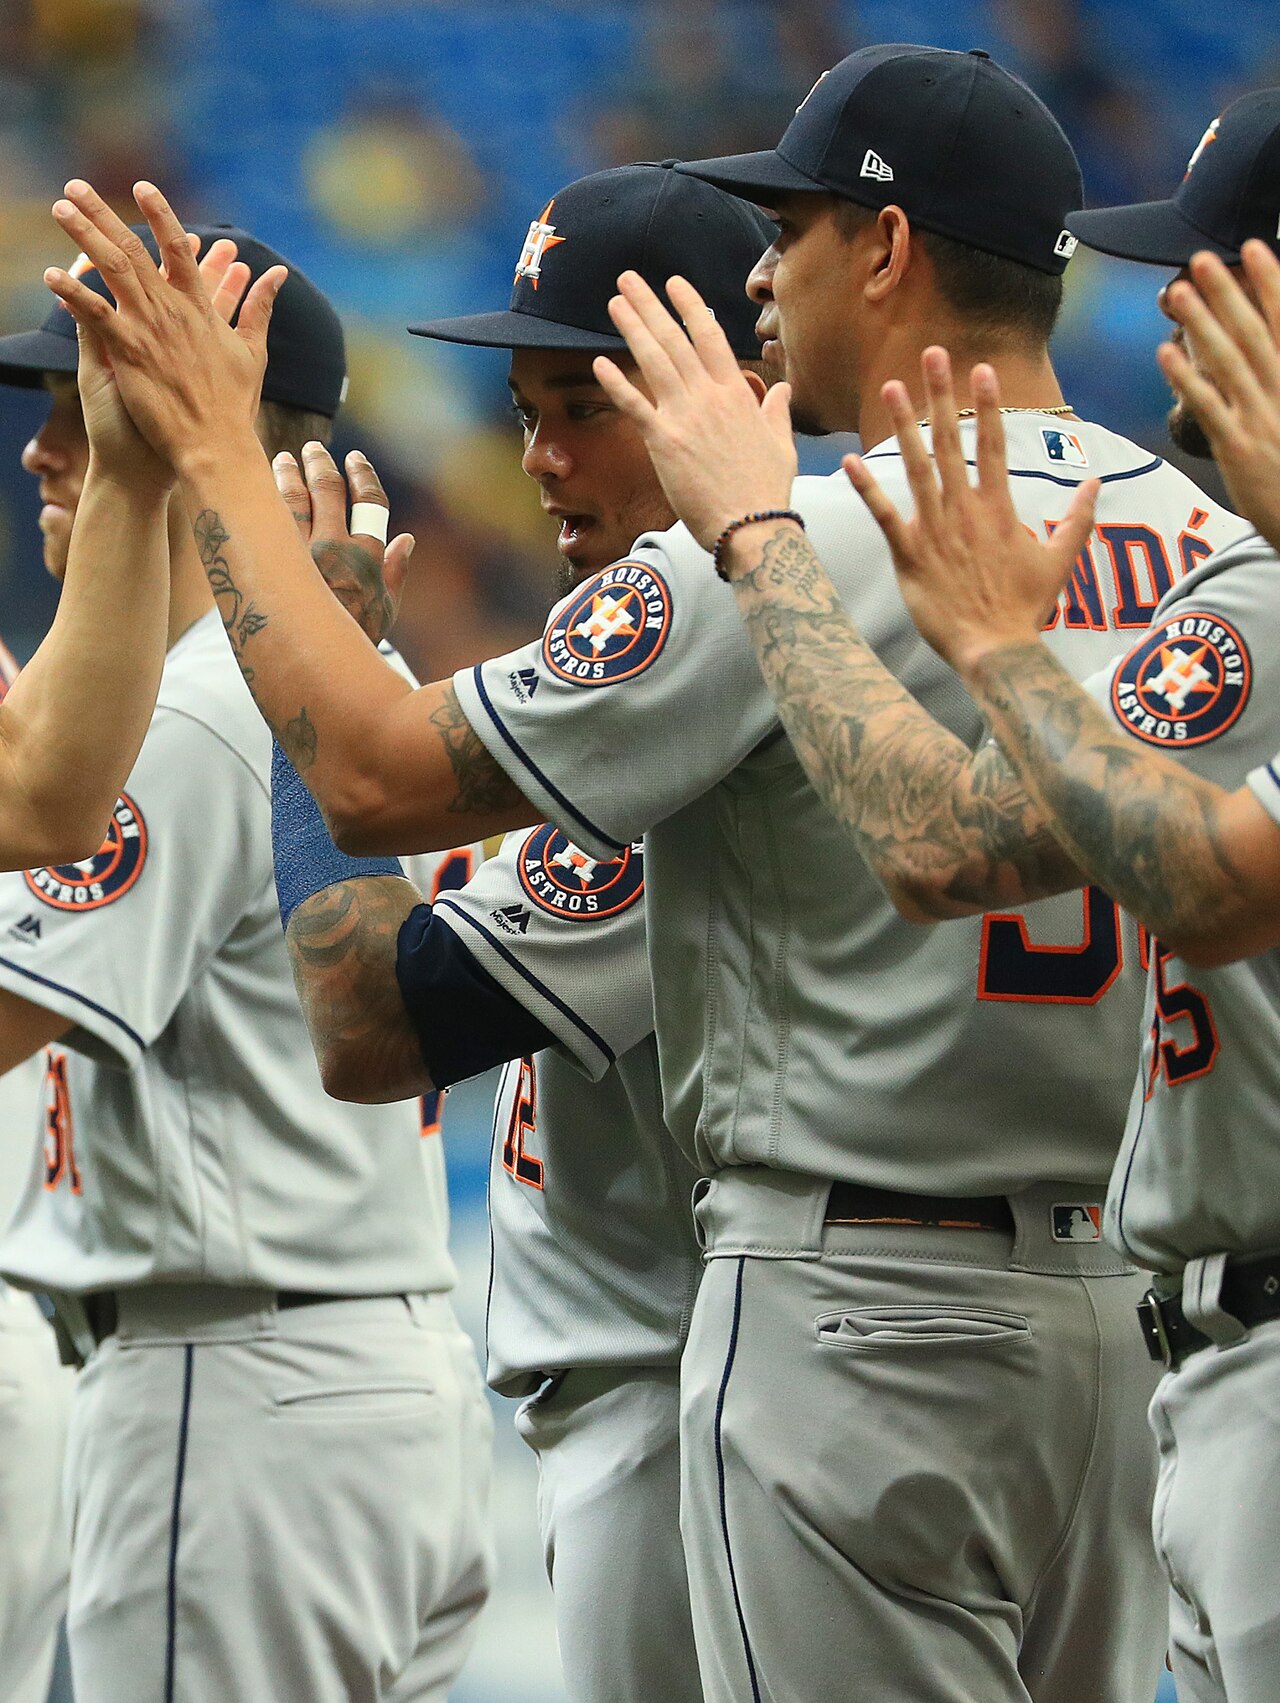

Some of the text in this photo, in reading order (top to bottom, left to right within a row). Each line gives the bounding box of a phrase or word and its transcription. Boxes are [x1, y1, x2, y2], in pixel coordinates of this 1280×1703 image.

[600, 567, 665, 631] HOUSTON
[550, 628, 606, 679] ASTROS
[1165, 618, 1244, 687] HOUSTON
[1118, 682, 1188, 740] ASTROS
[31, 868, 105, 903] STROS
[525, 858, 599, 912] ASTROS
